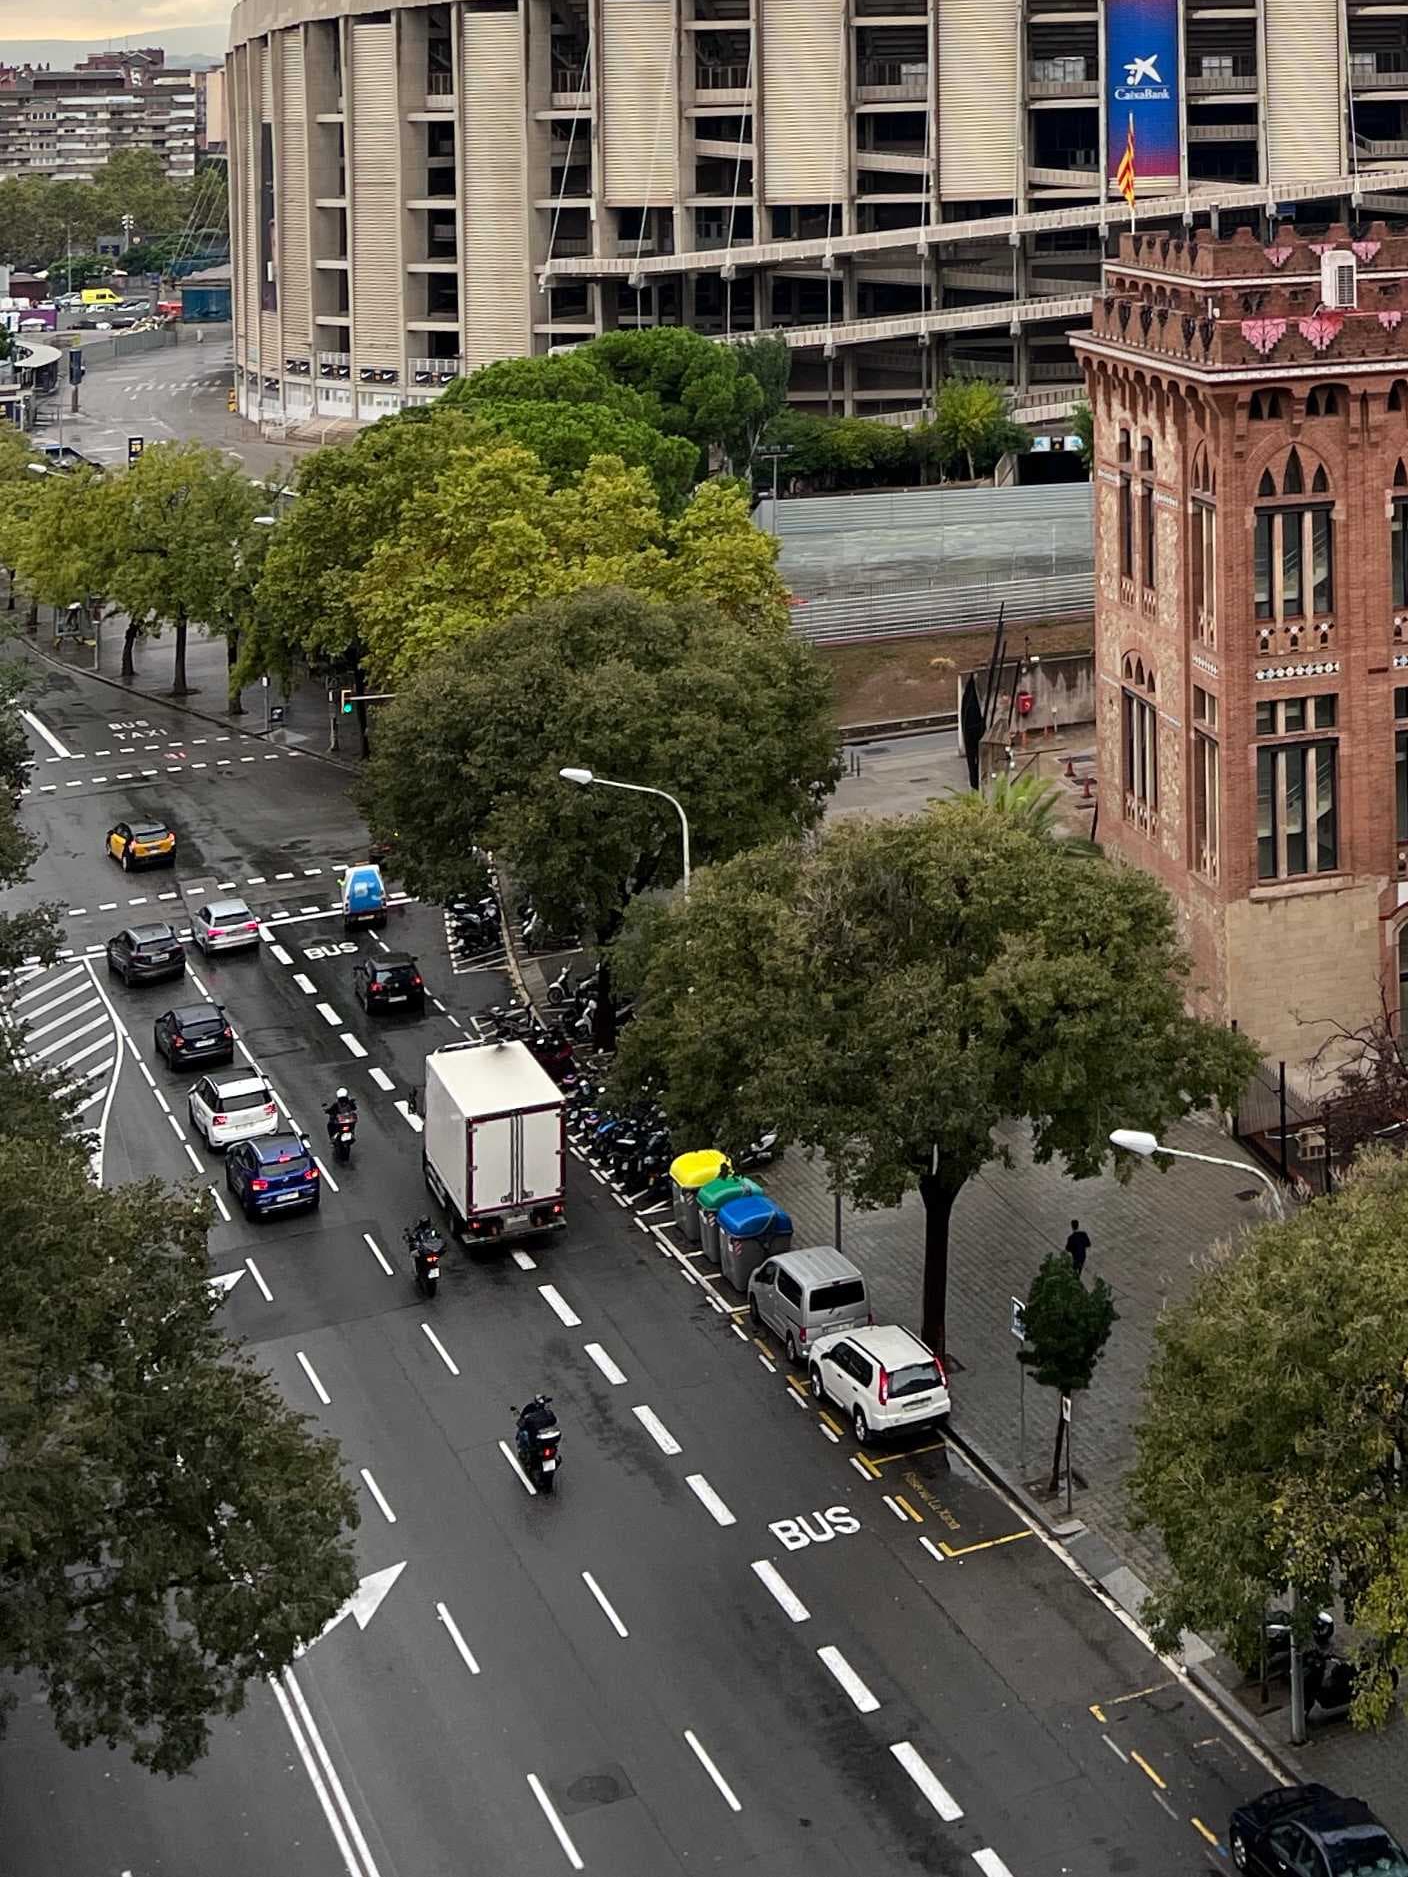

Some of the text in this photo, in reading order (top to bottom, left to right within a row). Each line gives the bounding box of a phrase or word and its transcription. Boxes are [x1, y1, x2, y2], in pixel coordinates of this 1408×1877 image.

[1114, 88, 1170, 100] CaixaBank
[108, 720, 149, 731] BUS
[113, 729, 168, 740] TAXI
[303, 942, 359, 961] BUS
[767, 1506, 861, 1551] BUS
